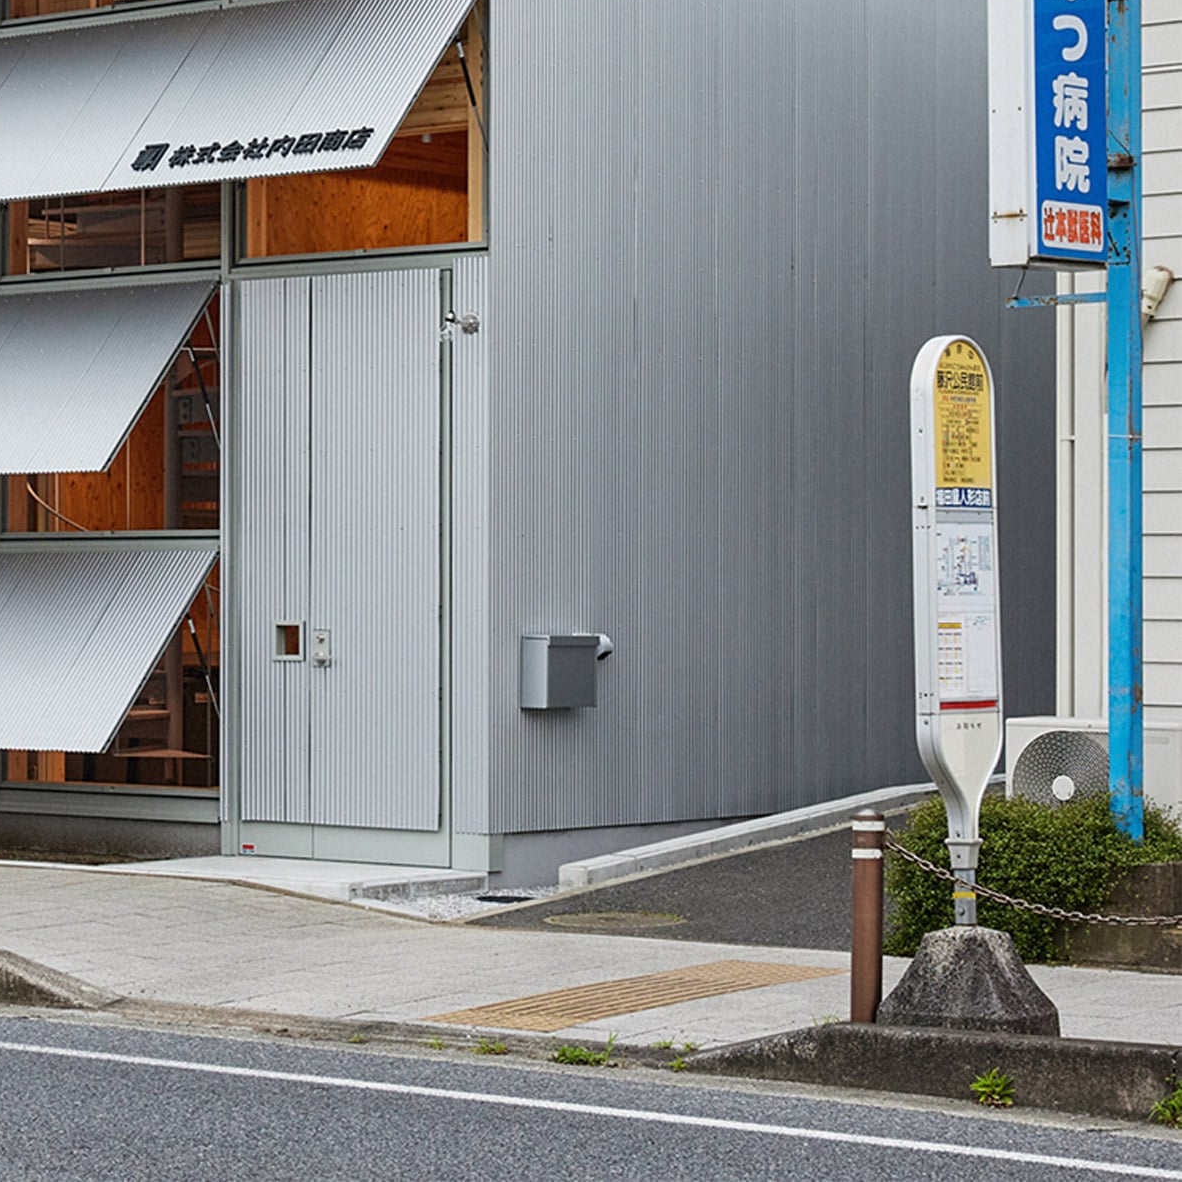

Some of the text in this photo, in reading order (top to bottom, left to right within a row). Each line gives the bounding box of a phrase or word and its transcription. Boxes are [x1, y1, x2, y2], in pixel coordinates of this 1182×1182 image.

[168, 126, 375, 169] 株式会社内田商店
[1044, 207, 1102, 246] 辻本獣医科
